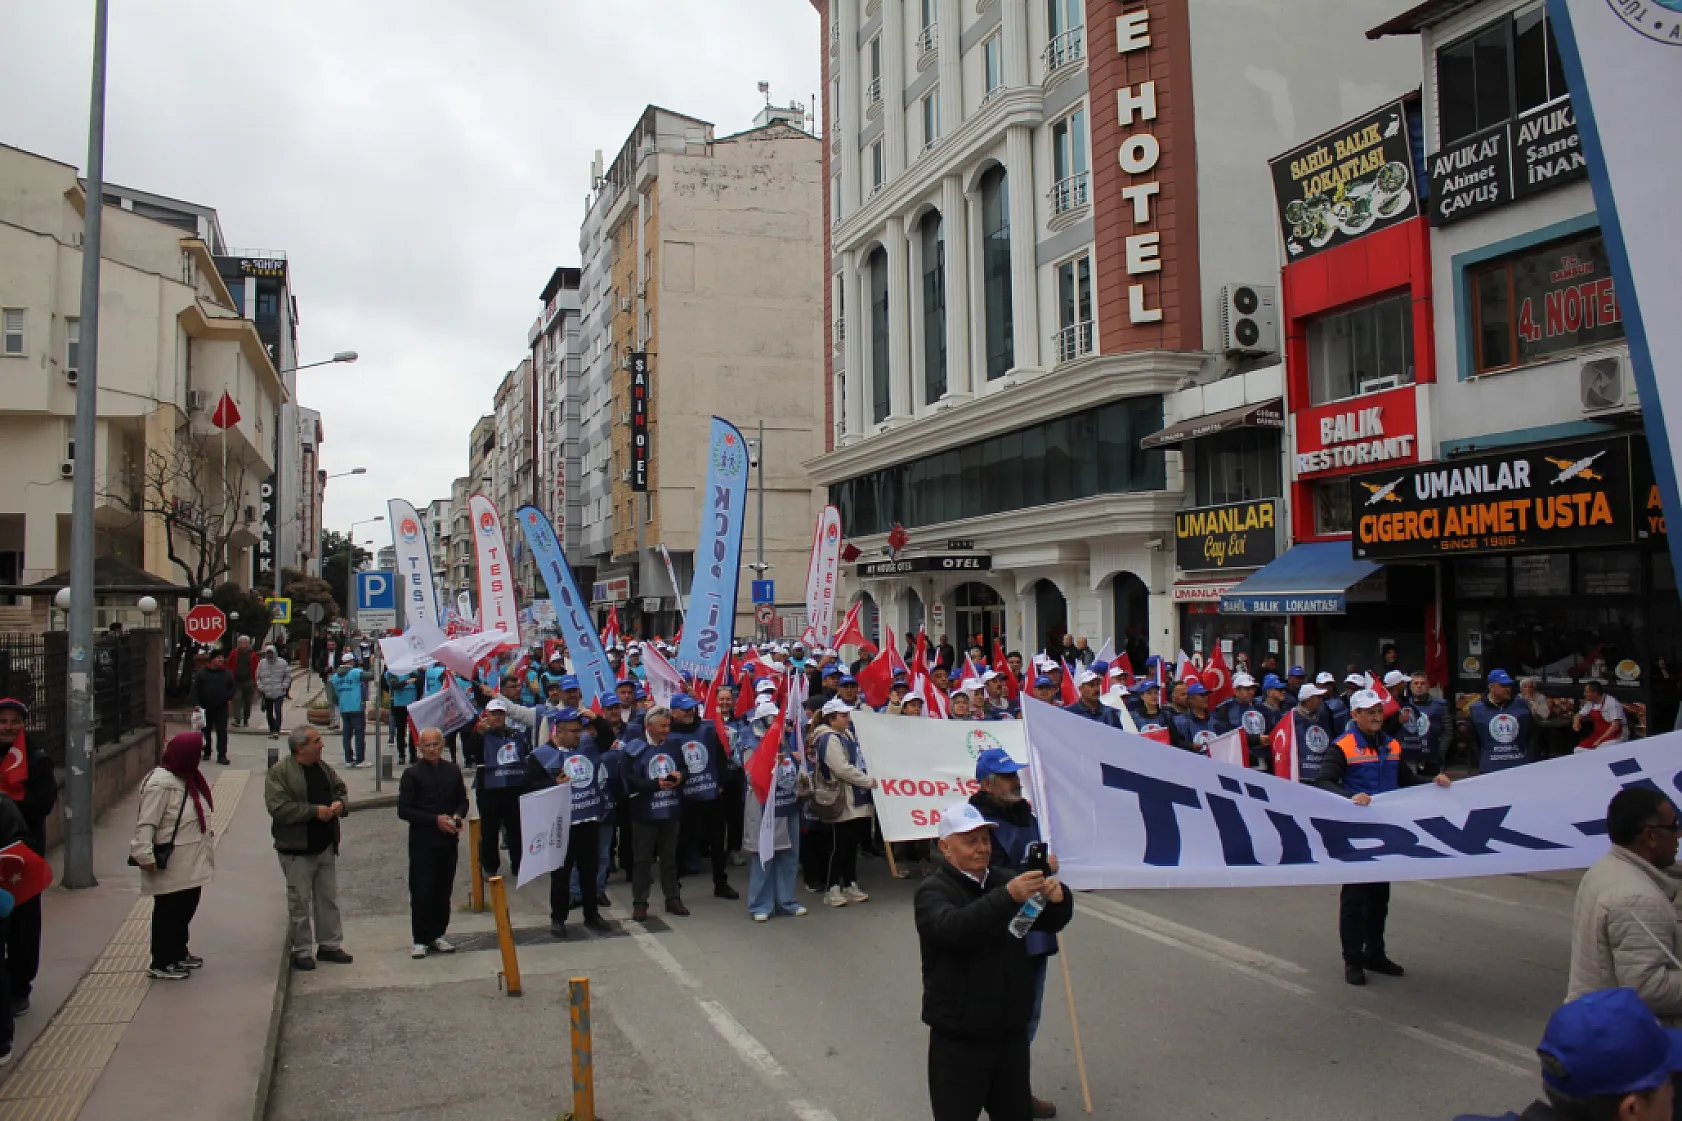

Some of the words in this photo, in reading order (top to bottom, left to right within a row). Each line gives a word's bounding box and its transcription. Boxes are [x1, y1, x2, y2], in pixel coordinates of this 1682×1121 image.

[1333, 122, 1382, 160] BALIK
[1517, 105, 1577, 146] AVUK
[1303, 146, 1386, 198] LOKANTASI
[1432, 134, 1501, 179] AVUKAT
[1439, 181, 1499, 218] ÇAVUŞ
[1442, 165, 1496, 196] Ahmet
[1117, 80, 1163, 323] HOTEL
[1549, 261, 1594, 283] SAMSUN
[1519, 297, 1541, 341] 4.
[1320, 406, 1384, 445] BALIK
[635, 435, 646, 485] OTEL
[1297, 434, 1414, 474] RESTORANT
[1414, 460, 1532, 500] UMANLAR
[1176, 503, 1274, 539] UMANLAR
[1444, 498, 1532, 538] AHMET
[1535, 491, 1614, 530] USTA
[943, 558, 980, 568] OTEL
[1228, 533, 1248, 556] Evi
[365, 574, 387, 607] P
[1223, 598, 1247, 612] SAHİL
[1253, 600, 1279, 612] BALIK
[188, 617, 223, 631] DUR
